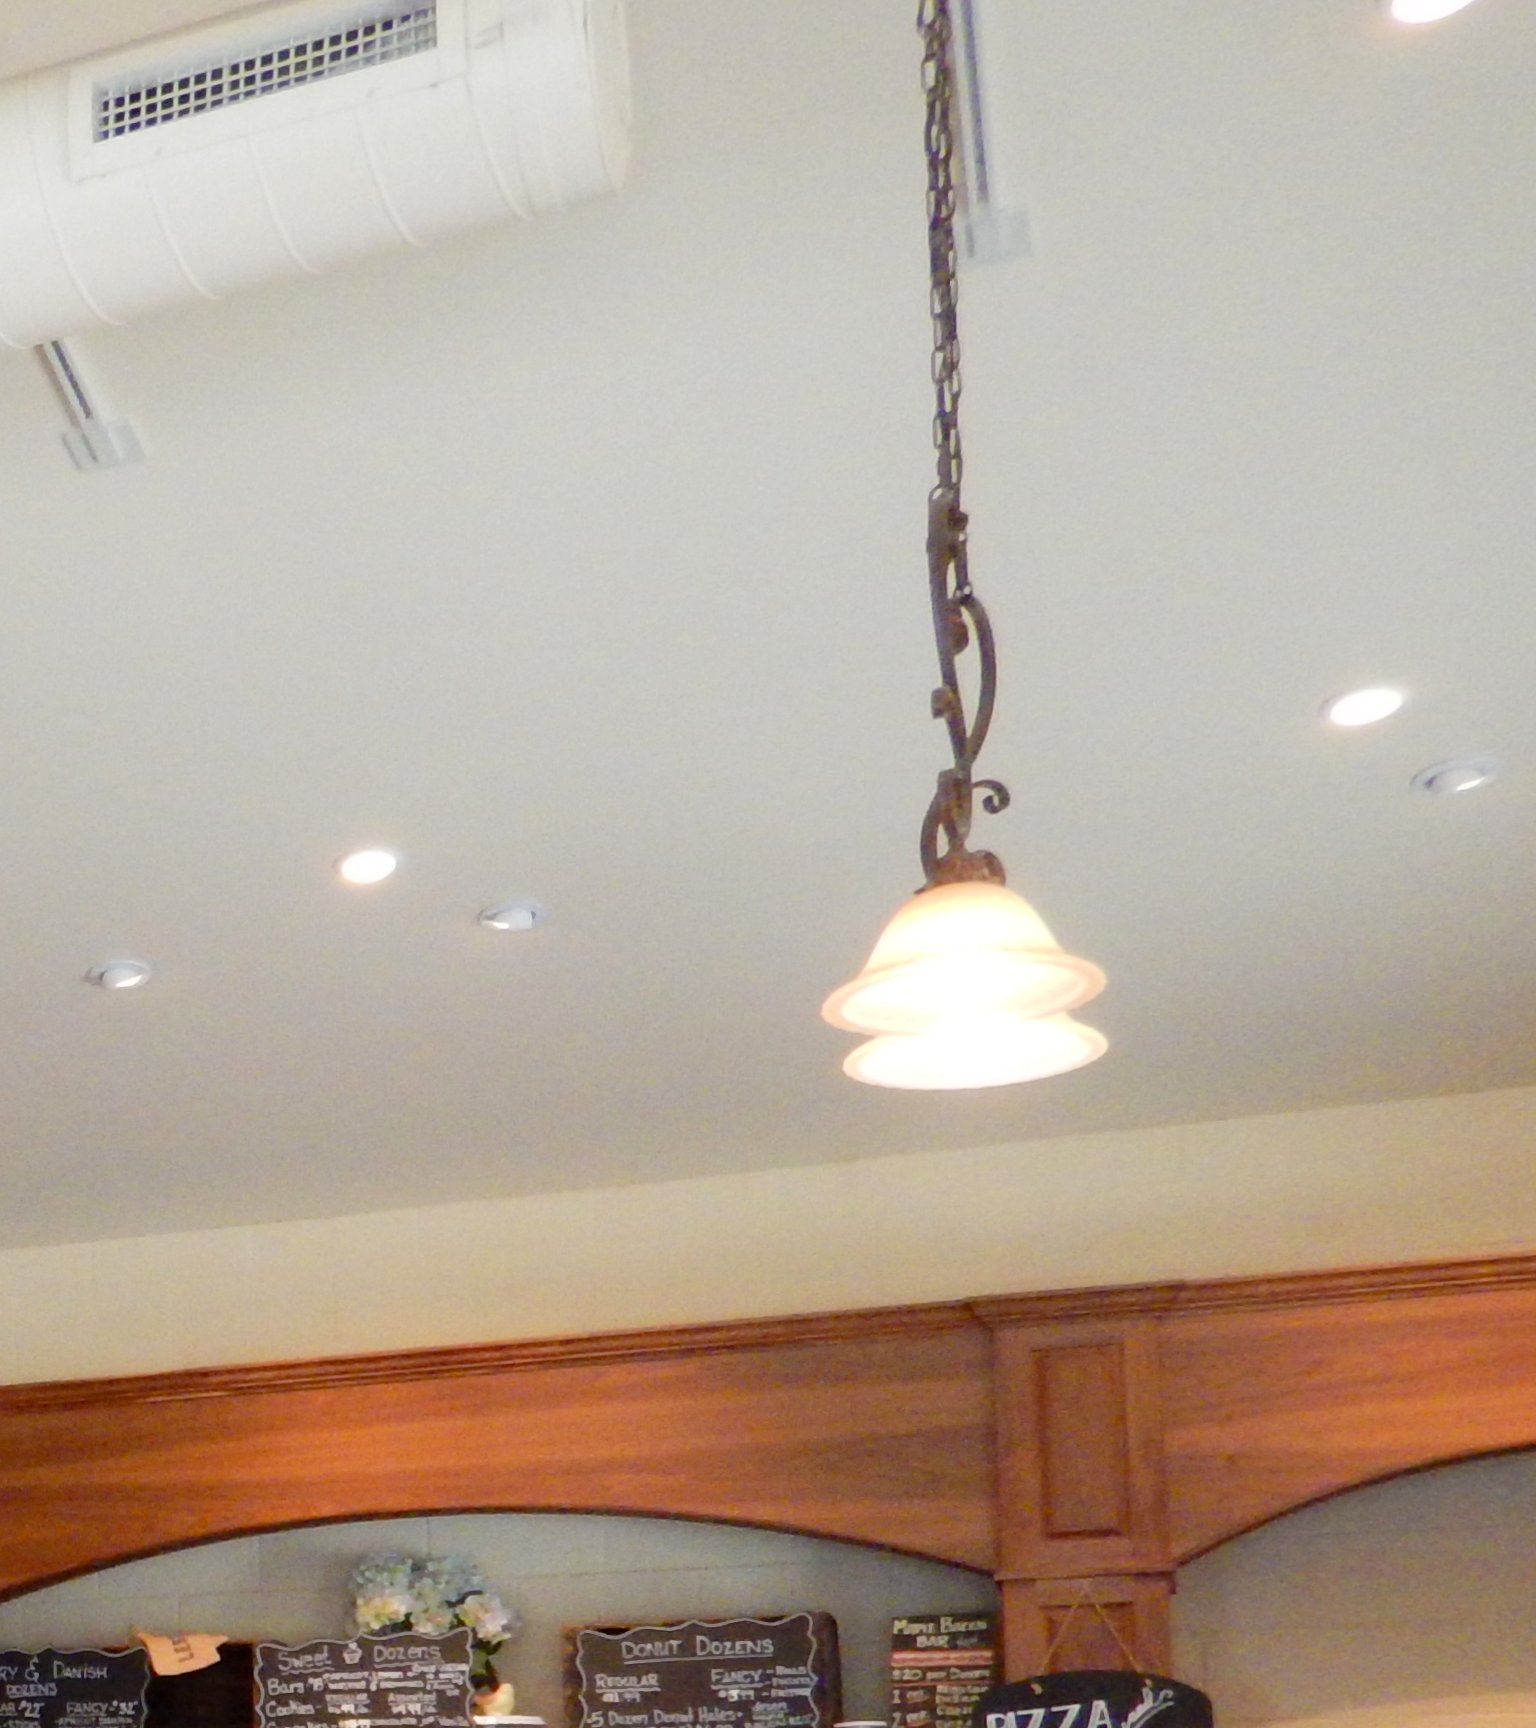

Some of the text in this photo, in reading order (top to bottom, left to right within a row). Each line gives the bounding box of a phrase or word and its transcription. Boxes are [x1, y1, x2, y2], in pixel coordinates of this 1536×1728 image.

[278, 1645, 442, 1671] Sweet Dozens
[267, 1677, 305, 1696] Bars
